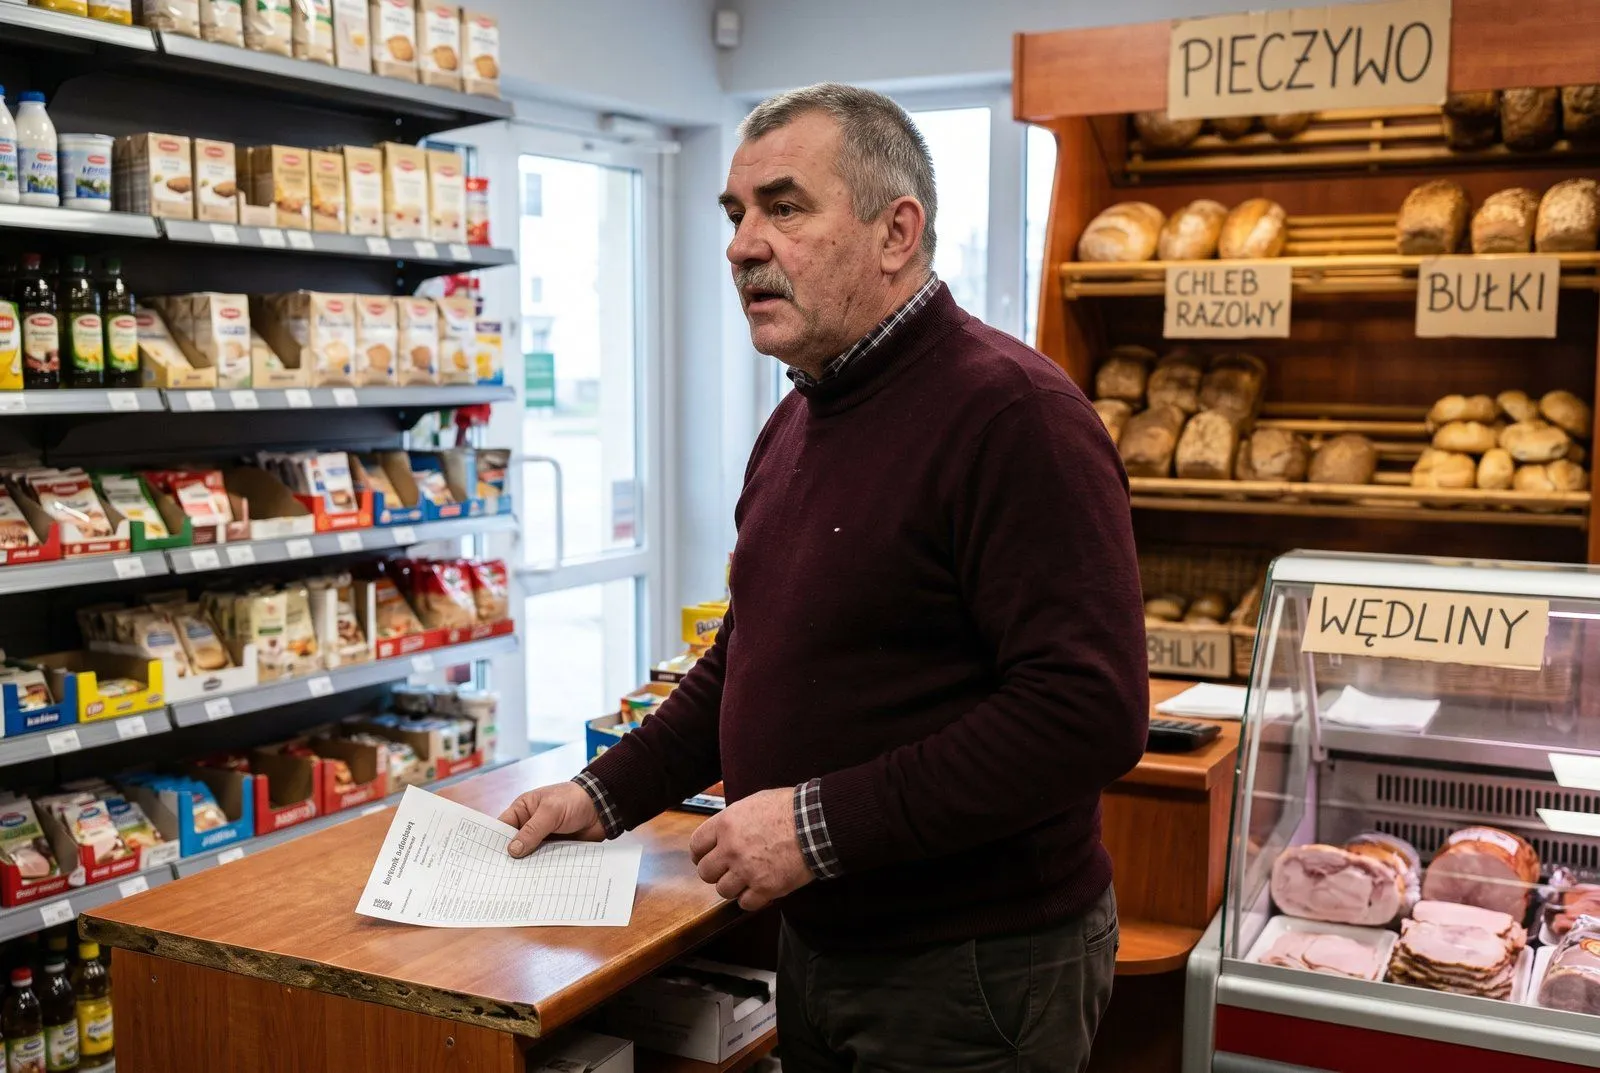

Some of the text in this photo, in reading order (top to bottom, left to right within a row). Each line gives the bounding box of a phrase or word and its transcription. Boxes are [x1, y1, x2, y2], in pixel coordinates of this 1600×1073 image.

[1178, 21, 1433, 97] PIECZYWO
[1174, 268, 1259, 296] CHLEB
[1427, 271, 1546, 312] BUŁKI
[1175, 299, 1284, 328] RAZOWY
[1319, 596, 1530, 650] WĘDLINY
